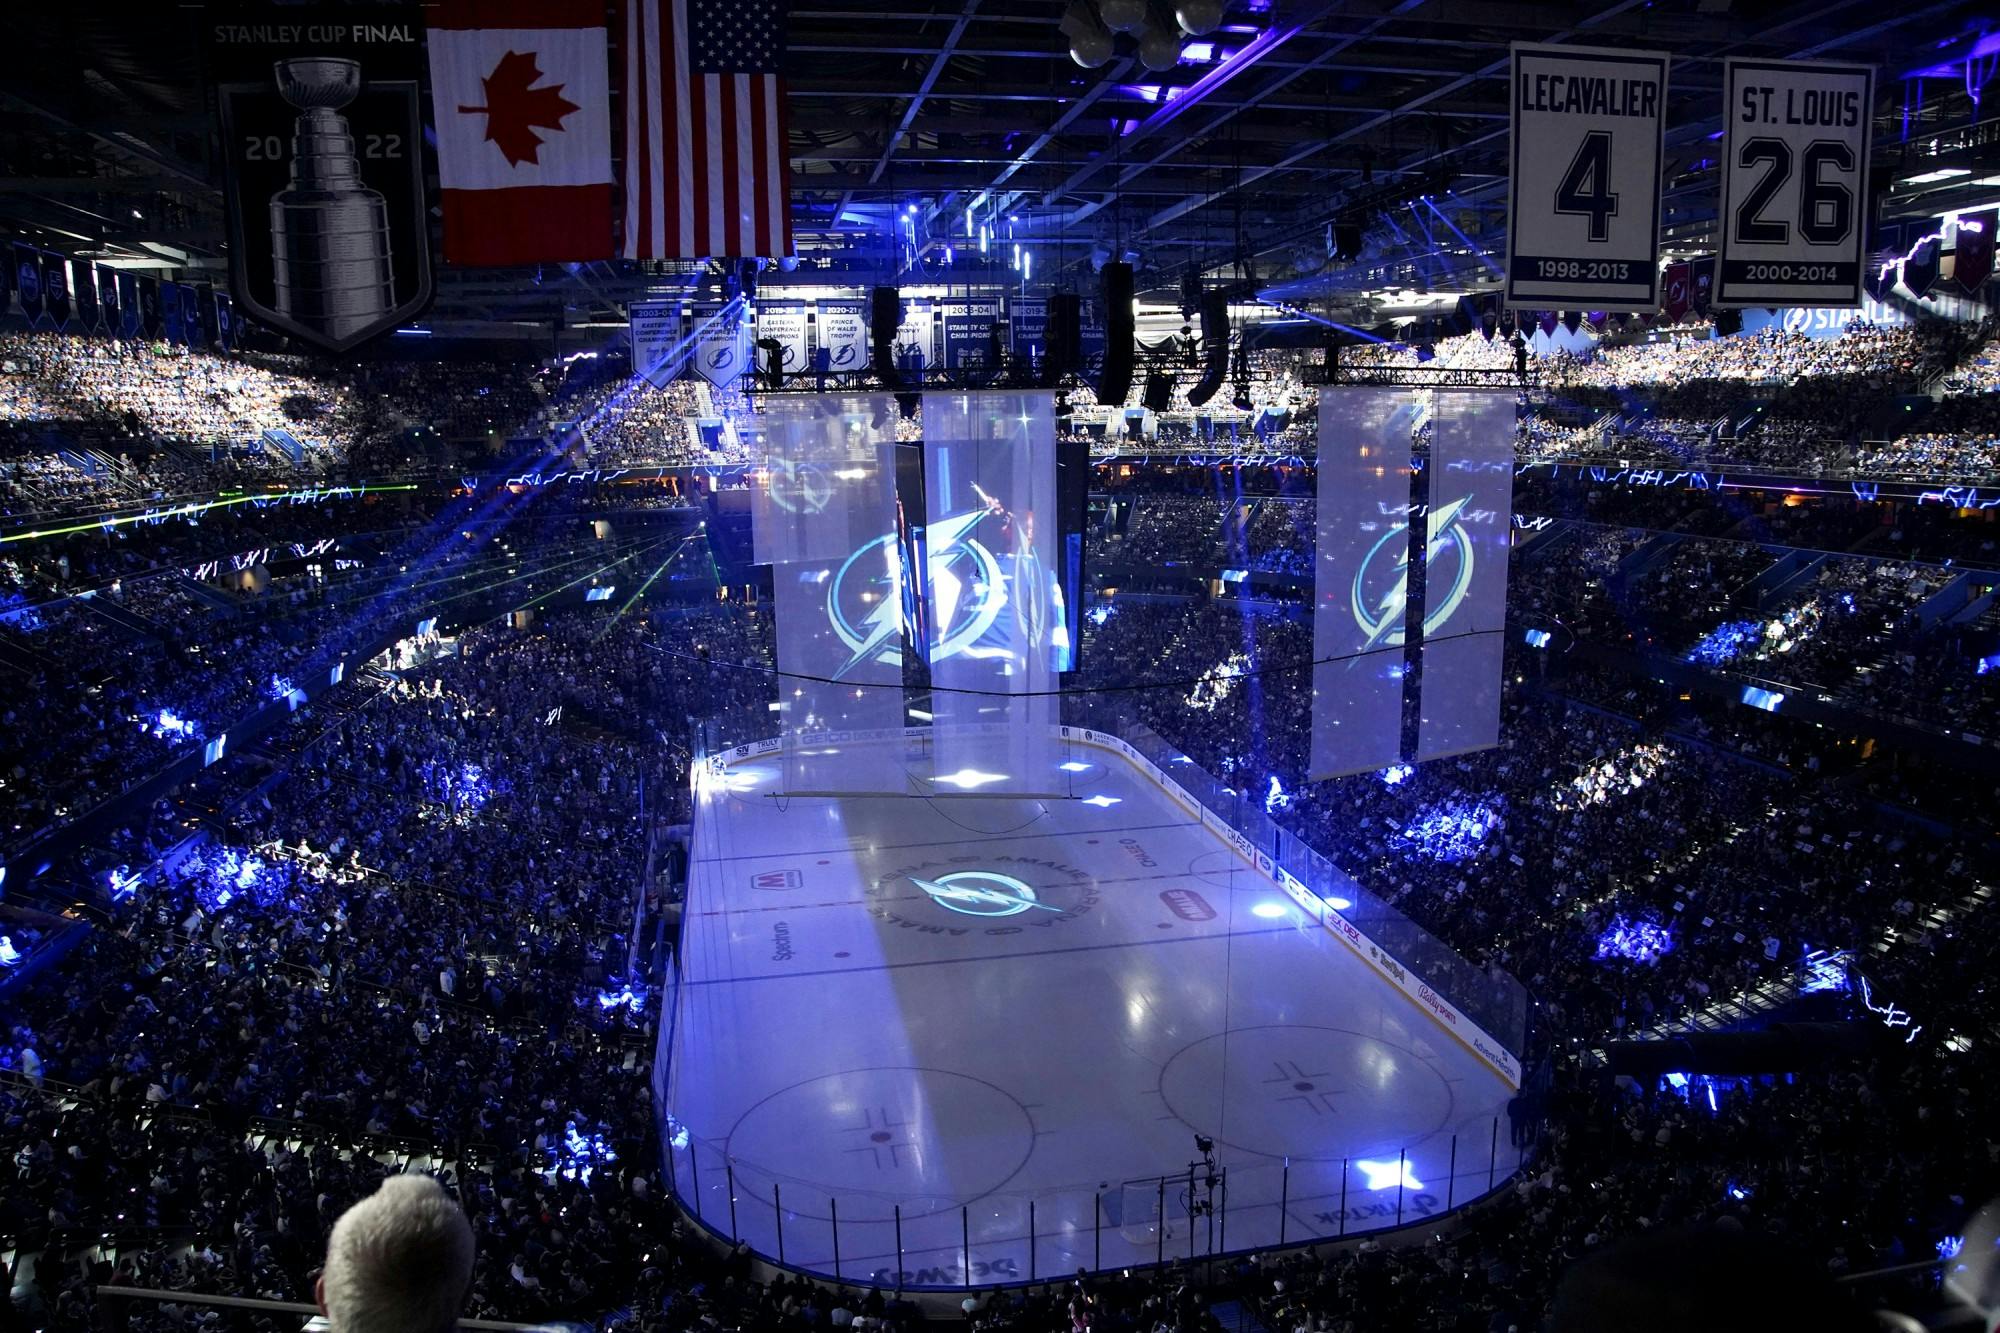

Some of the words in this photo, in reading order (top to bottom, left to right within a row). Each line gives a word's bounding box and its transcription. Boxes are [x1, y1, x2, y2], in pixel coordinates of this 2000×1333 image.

[214, 25, 301, 43] STANLEY
[307, 25, 346, 43] CUP
[352, 25, 415, 42] FINAL
[1522, 73, 1657, 118] LECAVALIER
[1741, 86, 1778, 124] ST.
[1786, 88, 1859, 127] LOUIS
[246, 136, 281, 160] 20
[366, 134, 401, 158] 22
[1554, 130, 1619, 243] 4
[1734, 136, 1855, 246] 26
[1537, 260, 1629, 280] 1998-2013
[1746, 265, 1837, 281] 2000-2014
[826, 306, 857, 314] 2020-21
[758, 738, 777, 748] TRULY
[803, 732, 850, 745] GEICO
[1344, 923, 1361, 942] DEX
[1417, 985, 1441, 1016] Bally
[1439, 1006, 1456, 1025] SPORTS
